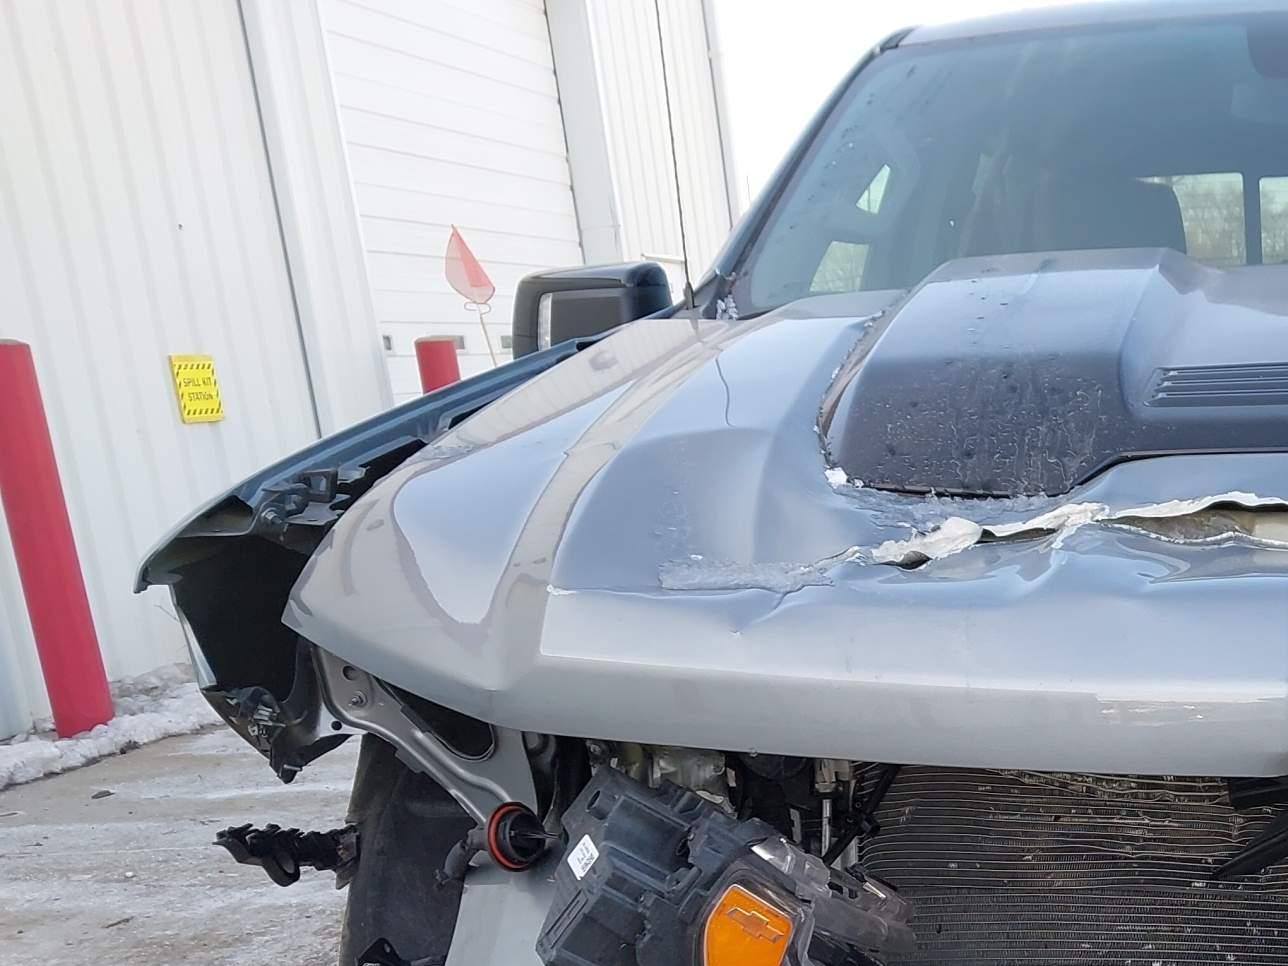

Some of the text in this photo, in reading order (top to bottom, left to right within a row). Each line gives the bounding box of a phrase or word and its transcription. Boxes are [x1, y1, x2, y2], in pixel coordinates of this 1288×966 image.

[183, 376, 212, 387] SPILL KIT
[187, 391, 214, 401] STATION
